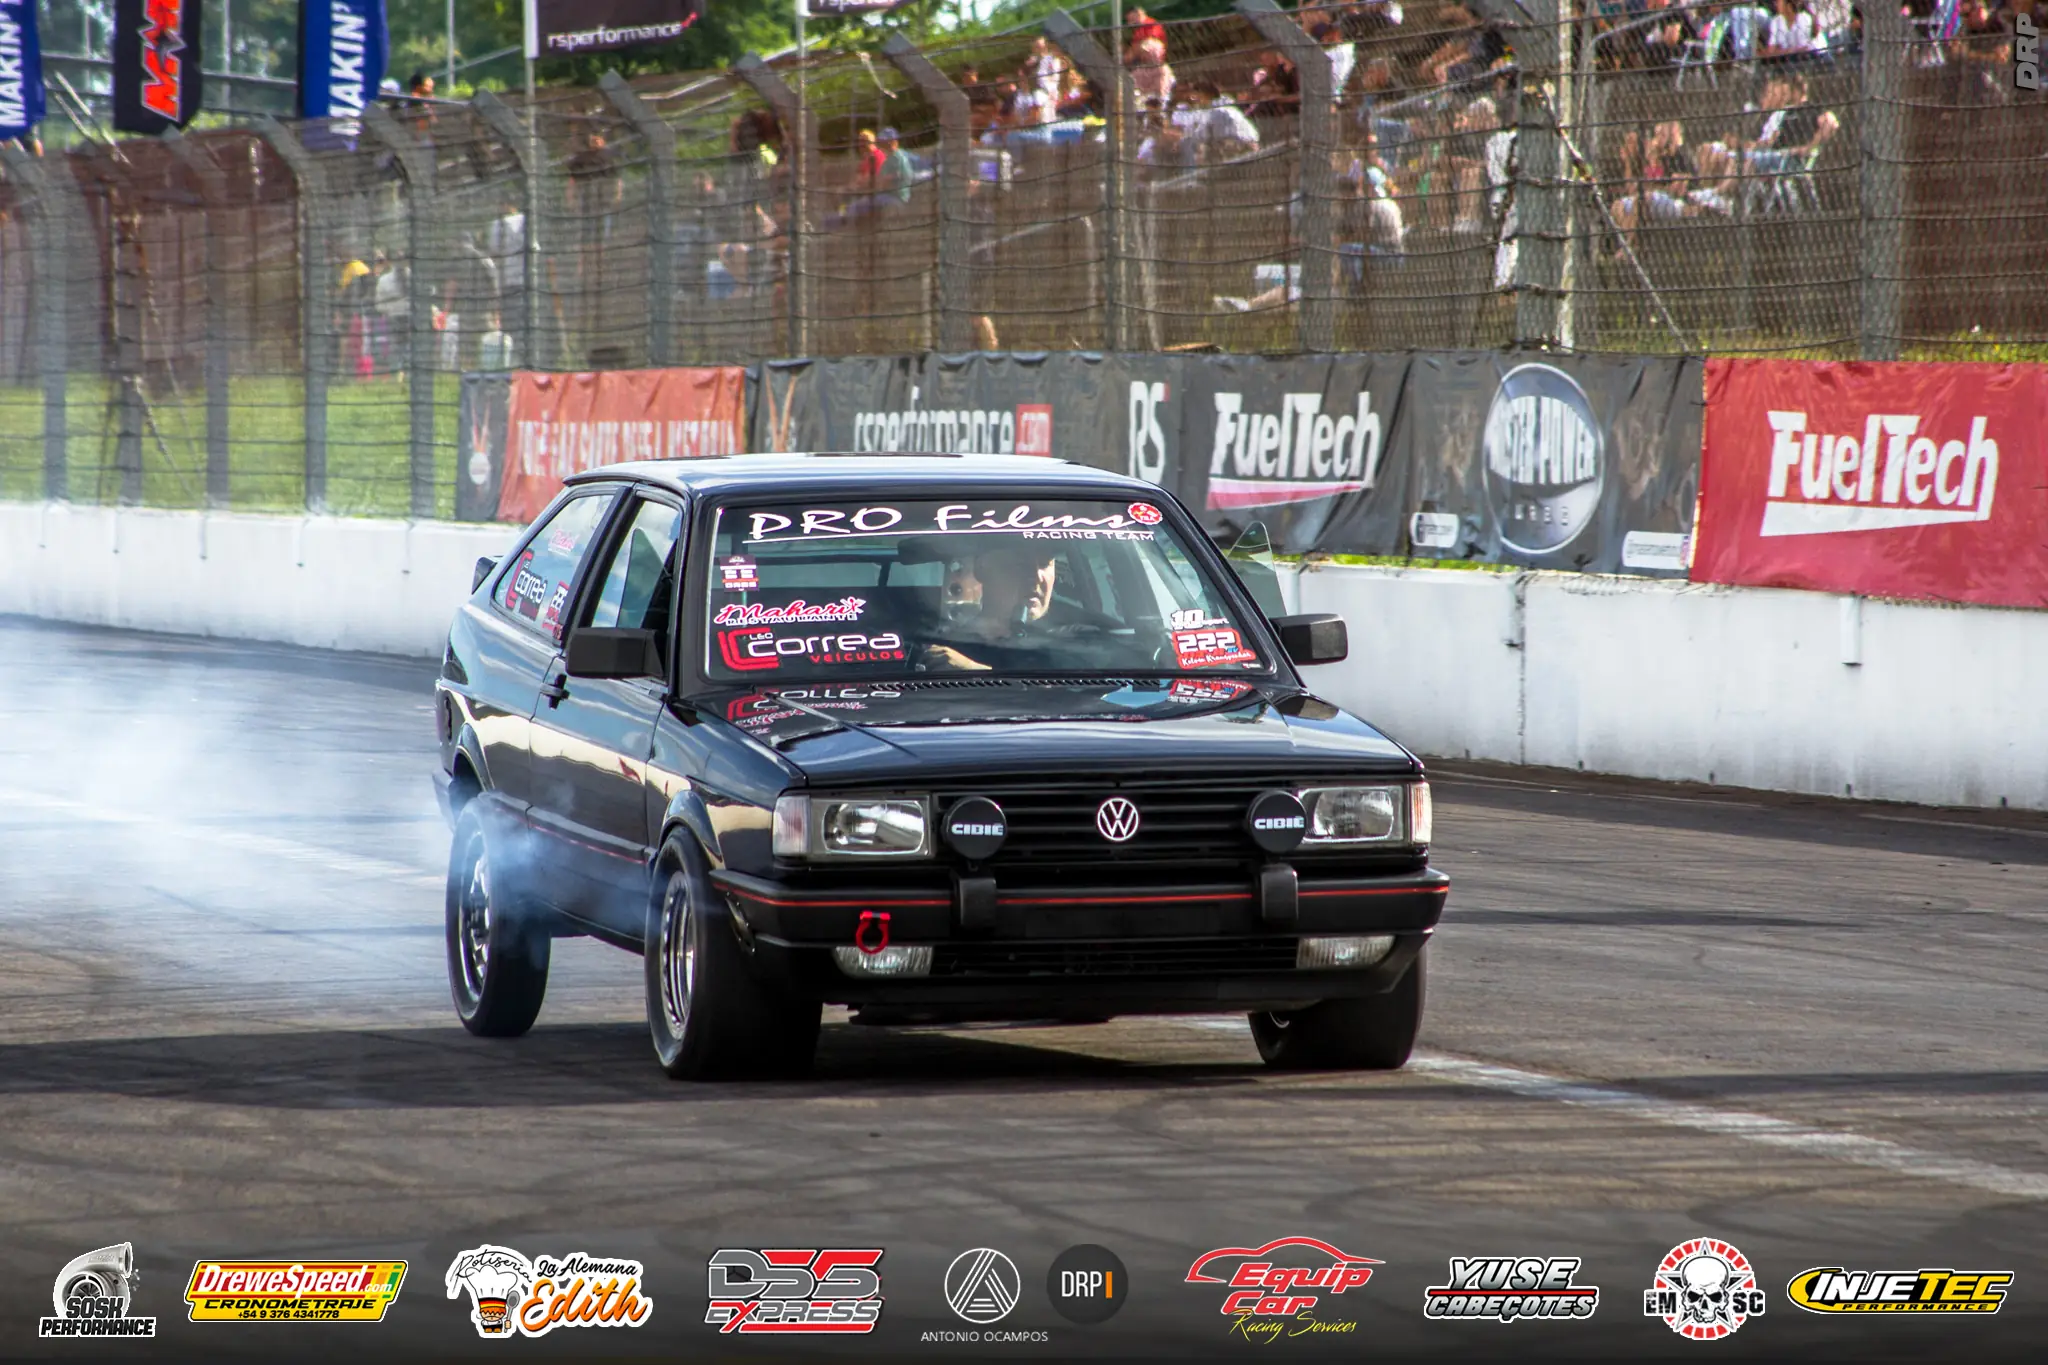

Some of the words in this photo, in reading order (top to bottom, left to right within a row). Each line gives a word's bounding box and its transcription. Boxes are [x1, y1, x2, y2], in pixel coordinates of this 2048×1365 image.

[547, 22, 683, 51] rsperformance
[1128, 381, 1170, 485] RS
[1209, 391, 1381, 488] FuelTech
[1767, 410, 1998, 520] FuelTech
[749, 507, 902, 540] PRO
[934, 504, 1137, 531] Films
[1023, 531, 1097, 540] RACING
[1101, 532, 1155, 541] TEAM
[1177, 632, 1236, 653] 222
